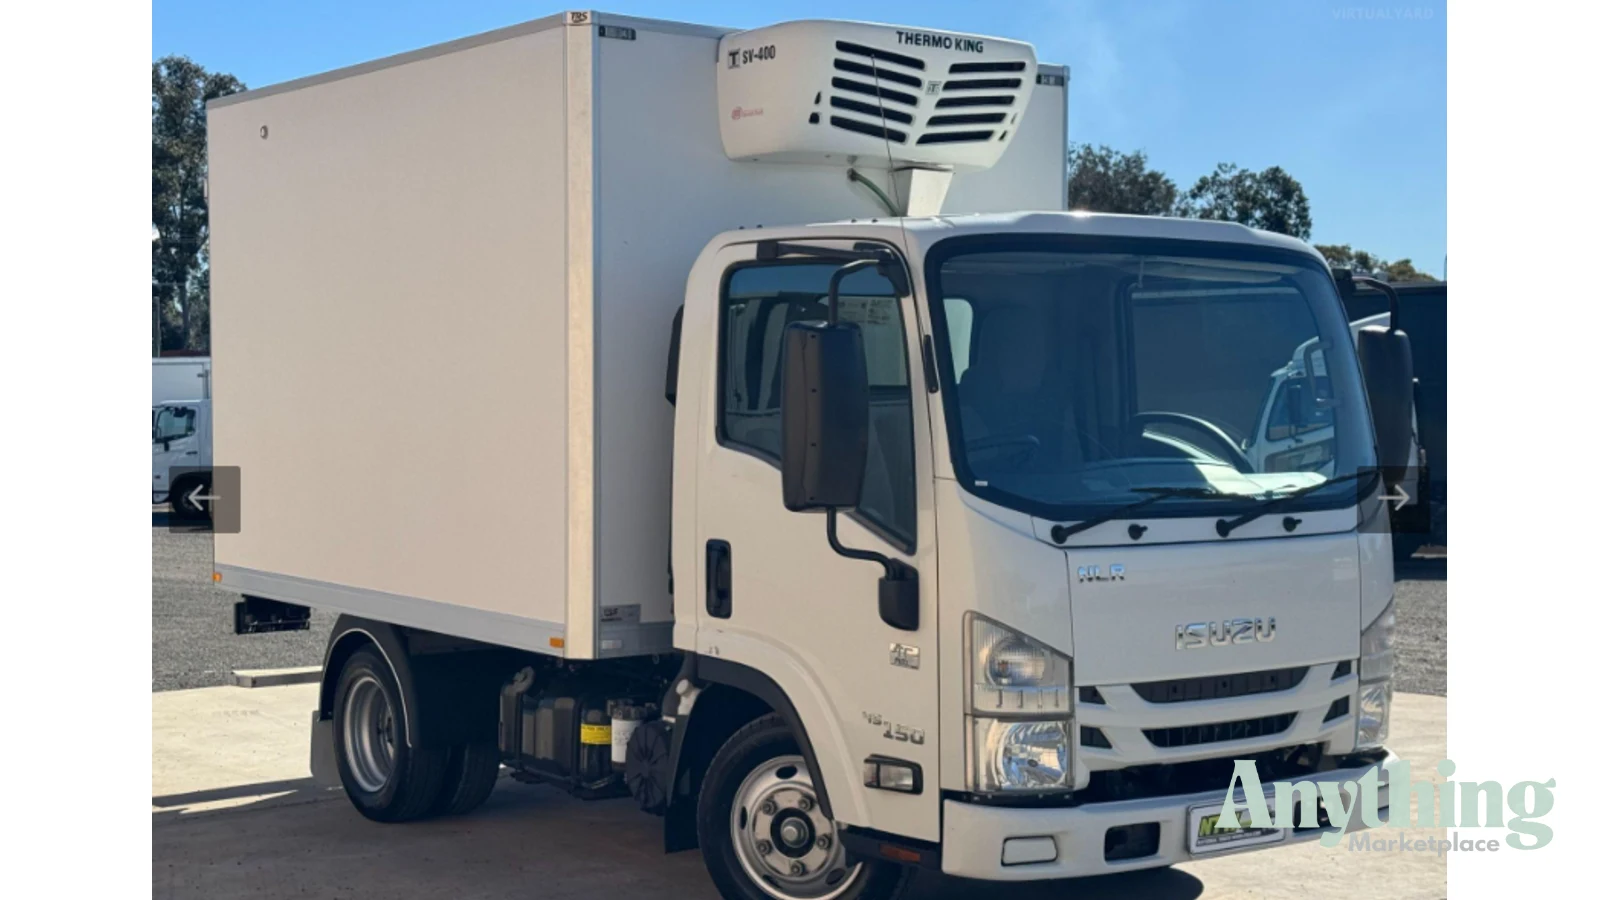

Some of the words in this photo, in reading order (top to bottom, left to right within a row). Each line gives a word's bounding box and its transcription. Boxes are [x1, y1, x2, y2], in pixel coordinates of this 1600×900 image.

[896, 30, 953, 49] THERMO
[954, 38, 984, 53] KING
[742, 44, 776, 65] SV-400
[1077, 563, 1126, 583] NLR
[1175, 616, 1277, 650] ISUZU
[883, 720, 925, 745] 150
